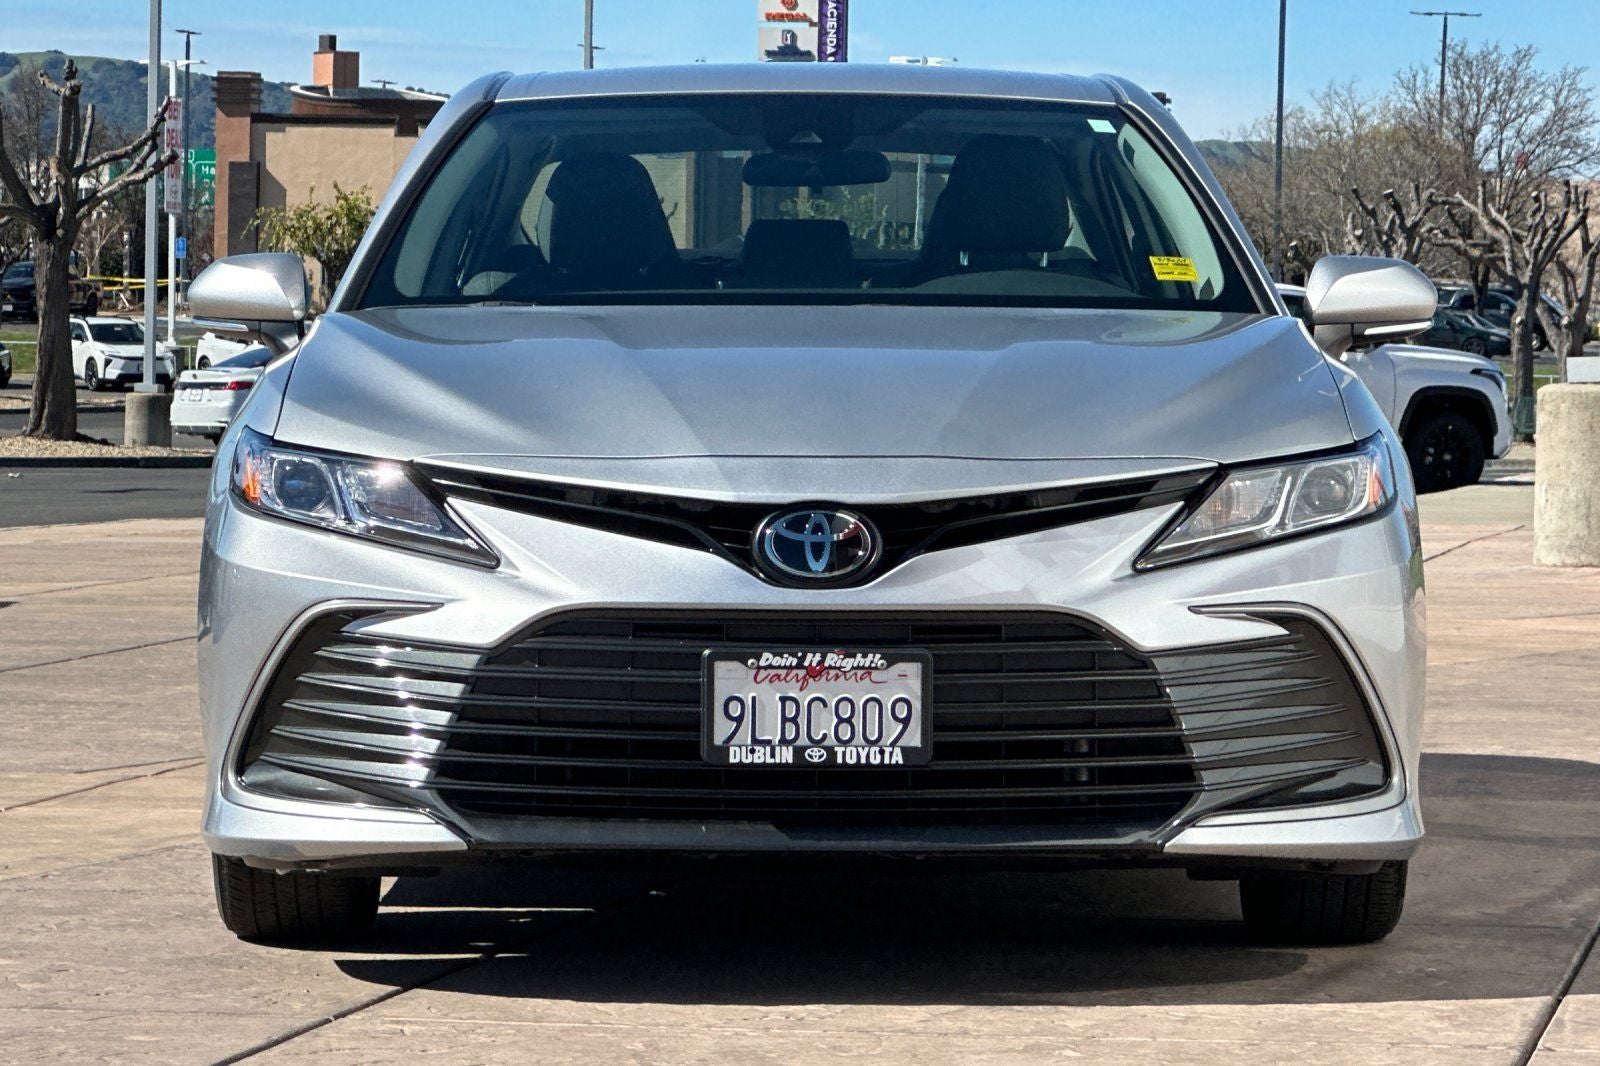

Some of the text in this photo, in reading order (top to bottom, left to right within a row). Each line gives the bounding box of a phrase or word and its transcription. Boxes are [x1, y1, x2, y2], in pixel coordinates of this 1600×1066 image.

[826, 0, 837, 54] ACIENDA
[759, 652, 882, 672] Doin' It Right!
[721, 694, 914, 746] 9LBC809
[728, 746, 904, 765] DUBLIN TOYOTA
